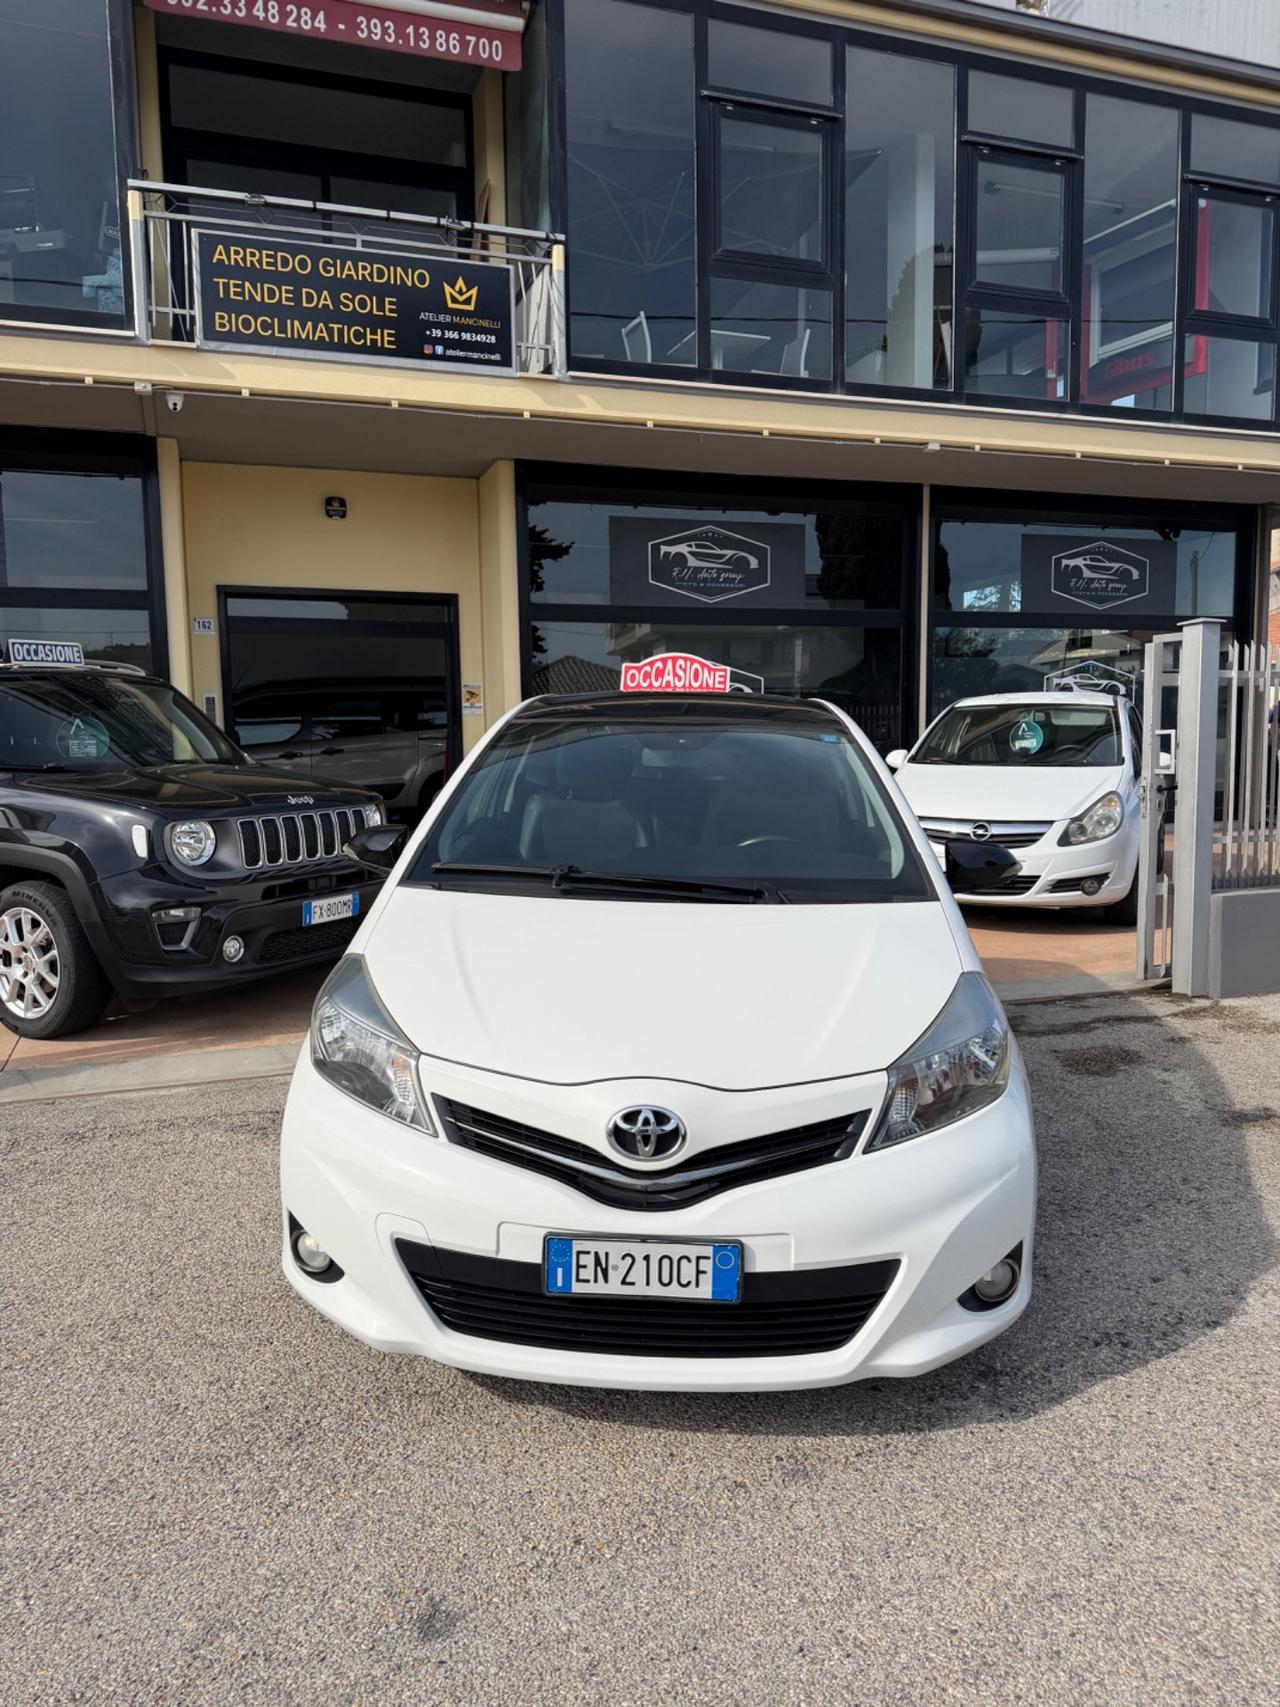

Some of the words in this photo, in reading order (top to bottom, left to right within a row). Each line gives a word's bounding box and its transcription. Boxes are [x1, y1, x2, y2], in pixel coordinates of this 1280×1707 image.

[212, 244, 312, 275] ARREDO
[318, 257, 430, 289] GIARDINO
[213, 278, 295, 306] TENDE
[301, 287, 334, 310] DA
[339, 292, 398, 317] SOLE
[214, 311, 397, 349] BIOCLIMATICHE
[419, 312, 452, 323] ATELIER
[452, 315, 501, 329] MANCINELLI
[425, 328, 442, 337] +39
[444, 330, 460, 340] 366
[460, 332, 497, 344] 9834928
[197, 620, 212, 630] 162
[13, 643, 81, 663] OCCASIONE
[626, 658, 726, 689] OCCASIONE
[287, 794, 315, 805] Jeep
